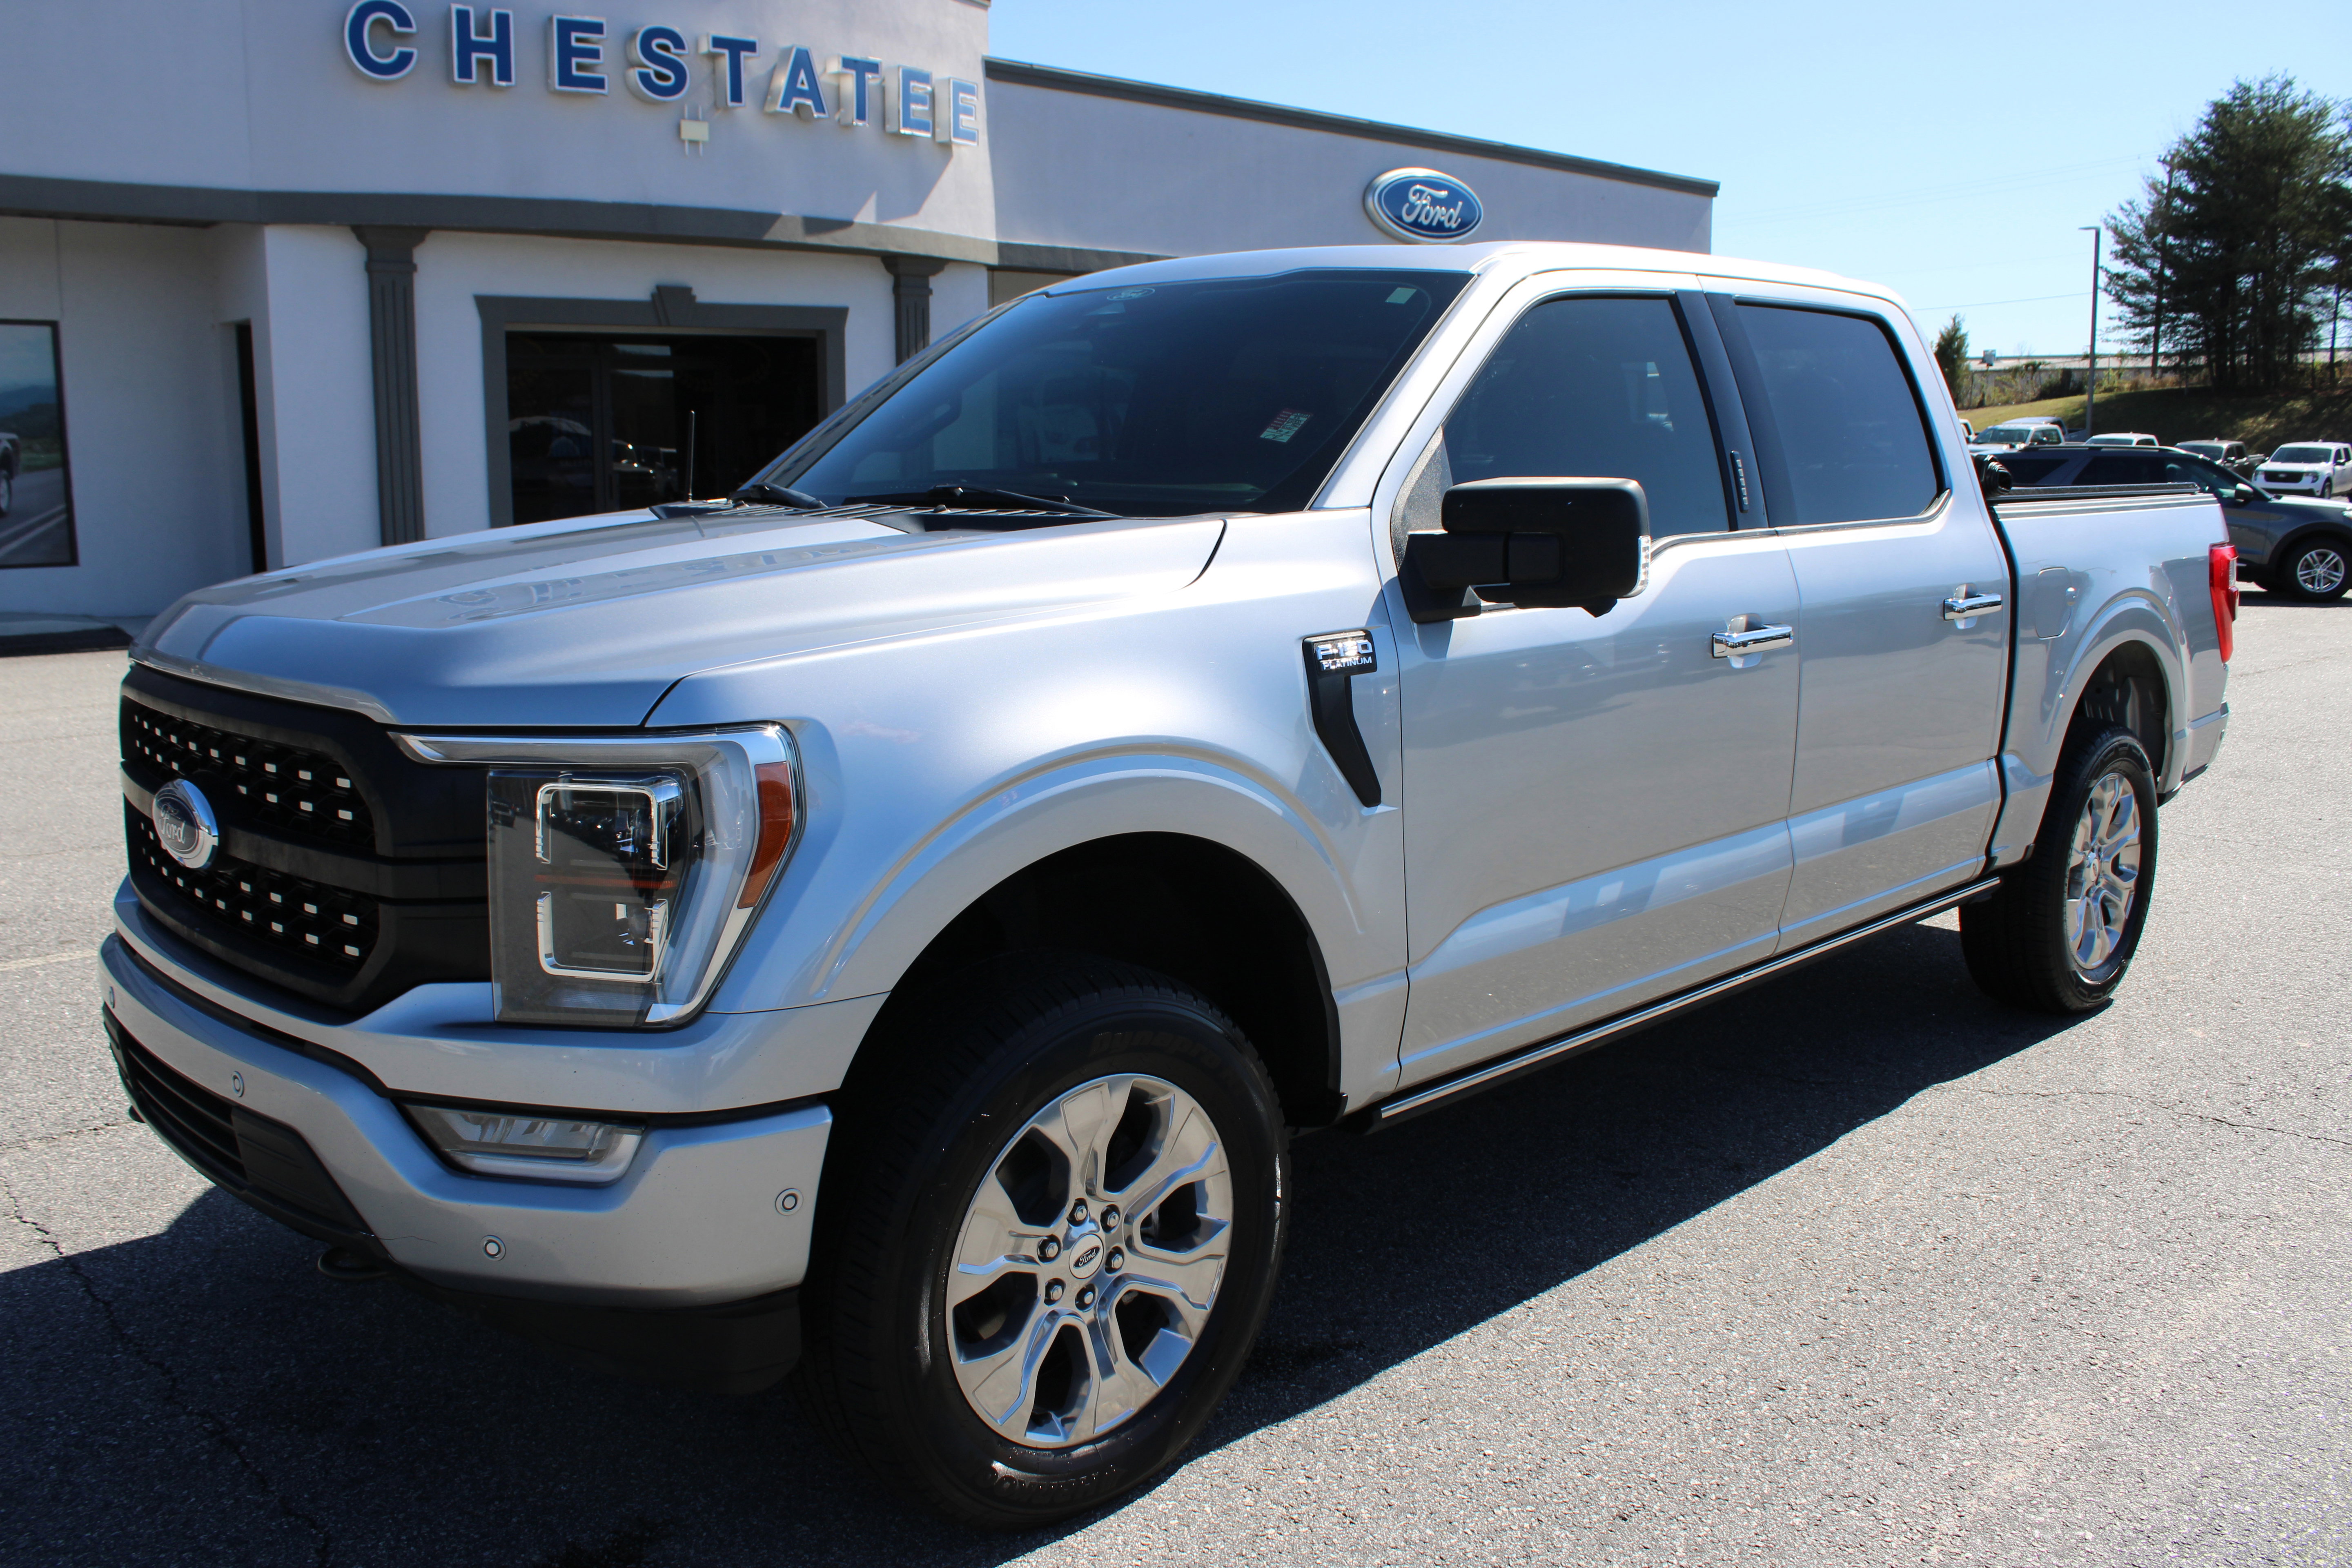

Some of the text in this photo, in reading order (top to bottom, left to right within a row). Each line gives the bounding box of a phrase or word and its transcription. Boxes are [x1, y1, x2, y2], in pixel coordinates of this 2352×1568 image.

[344, 0, 978, 146] CHESTATEE
[1401, 184, 1463, 228] Ford
[1316, 639, 1372, 660] F-150
[1321, 656, 1372, 670] PLATINUM
[159, 803, 186, 844] Ford
[1089, 1031, 1222, 1069] Dynapro
[1079, 1249, 1096, 1266] Ford
